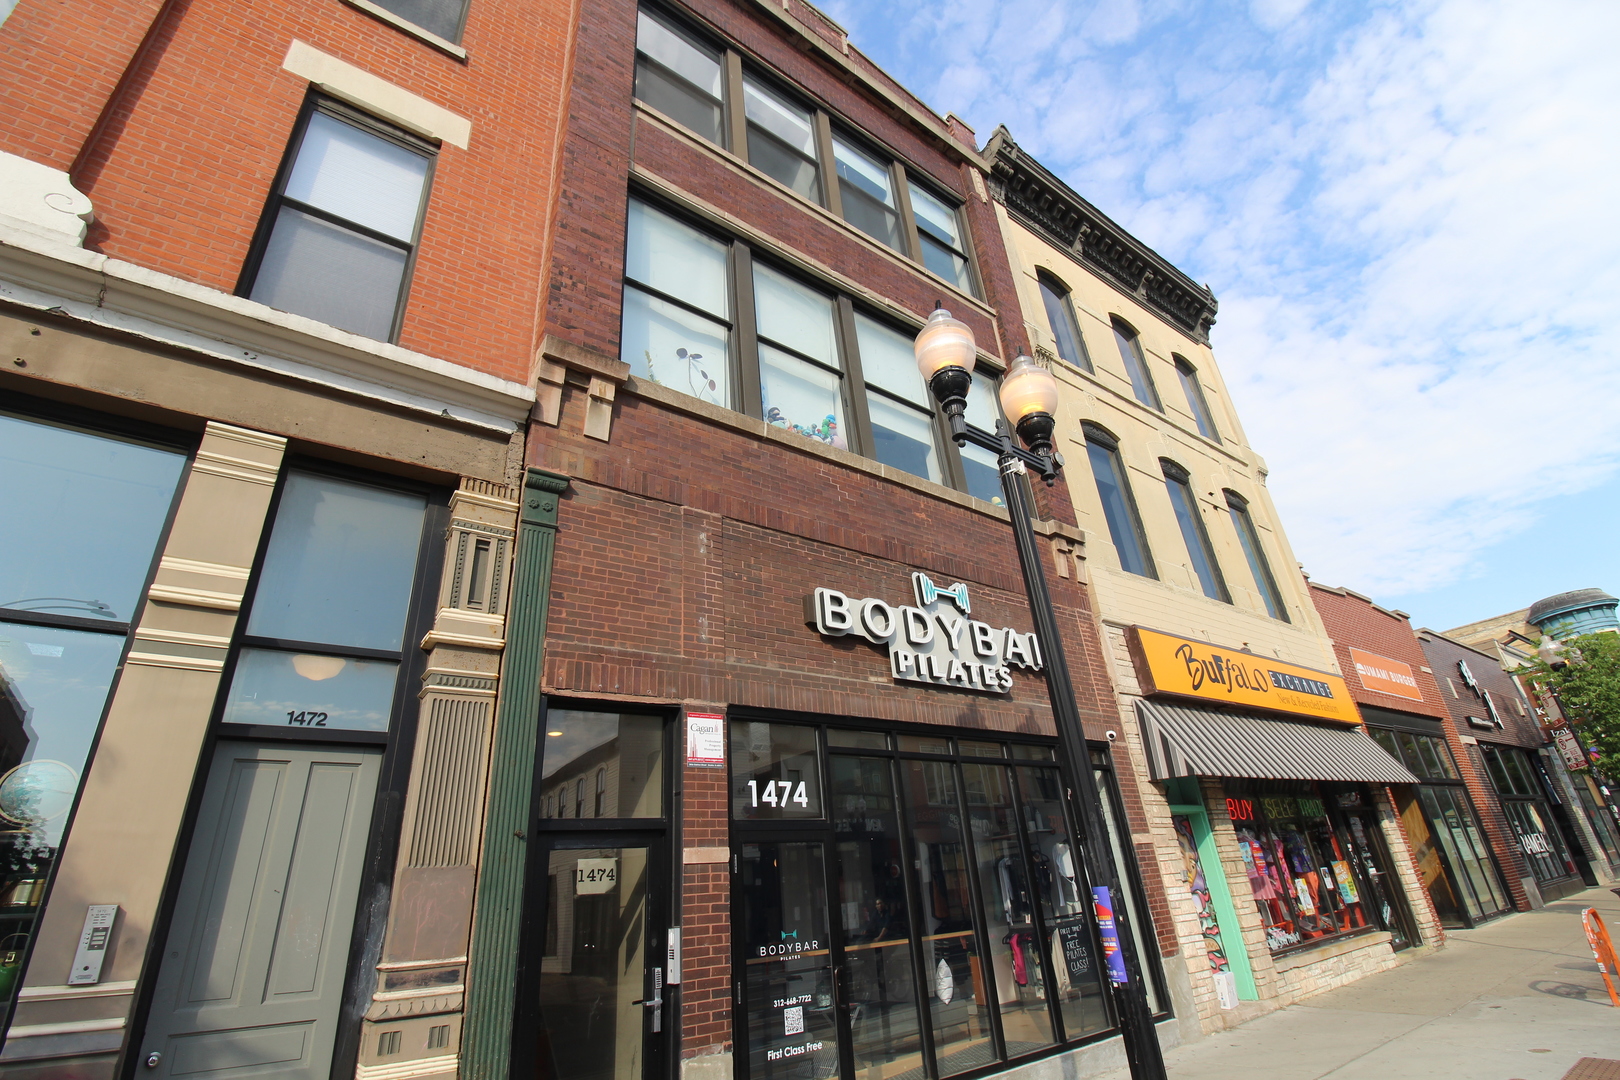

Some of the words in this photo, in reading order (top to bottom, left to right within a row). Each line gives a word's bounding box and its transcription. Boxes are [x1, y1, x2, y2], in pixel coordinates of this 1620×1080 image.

[893, 649, 1014, 688] PILATES
[1364, 664, 1390, 681] UMAMI
[1390, 670, 1417, 688] BURGER
[1269, 671, 1333, 698] EXCHANGE
[1276, 692, 1290, 705] New
[1296, 696, 1320, 710] Recycled
[1320, 700, 1340, 713] Fashion
[287, 710, 328, 727] 1472
[690, 722, 714, 735] Cagan
[746, 780, 809, 808] 1474
[1226, 798, 1254, 821] BUY
[1264, 798, 1295, 819] SELL
[578, 868, 615, 883] 1474
[759, 940, 819, 957] BODYBAR
[1066, 939, 1080, 951] FREE
[1066, 947, 1088, 960] PILATES
[1070, 957, 1090, 971] CLASS!
[773, 994, 812, 1008] 312-668-7722
[767, 1047, 783, 1061] First
[784, 1044, 805, 1057] Class
[806, 1041, 823, 1052] Free
